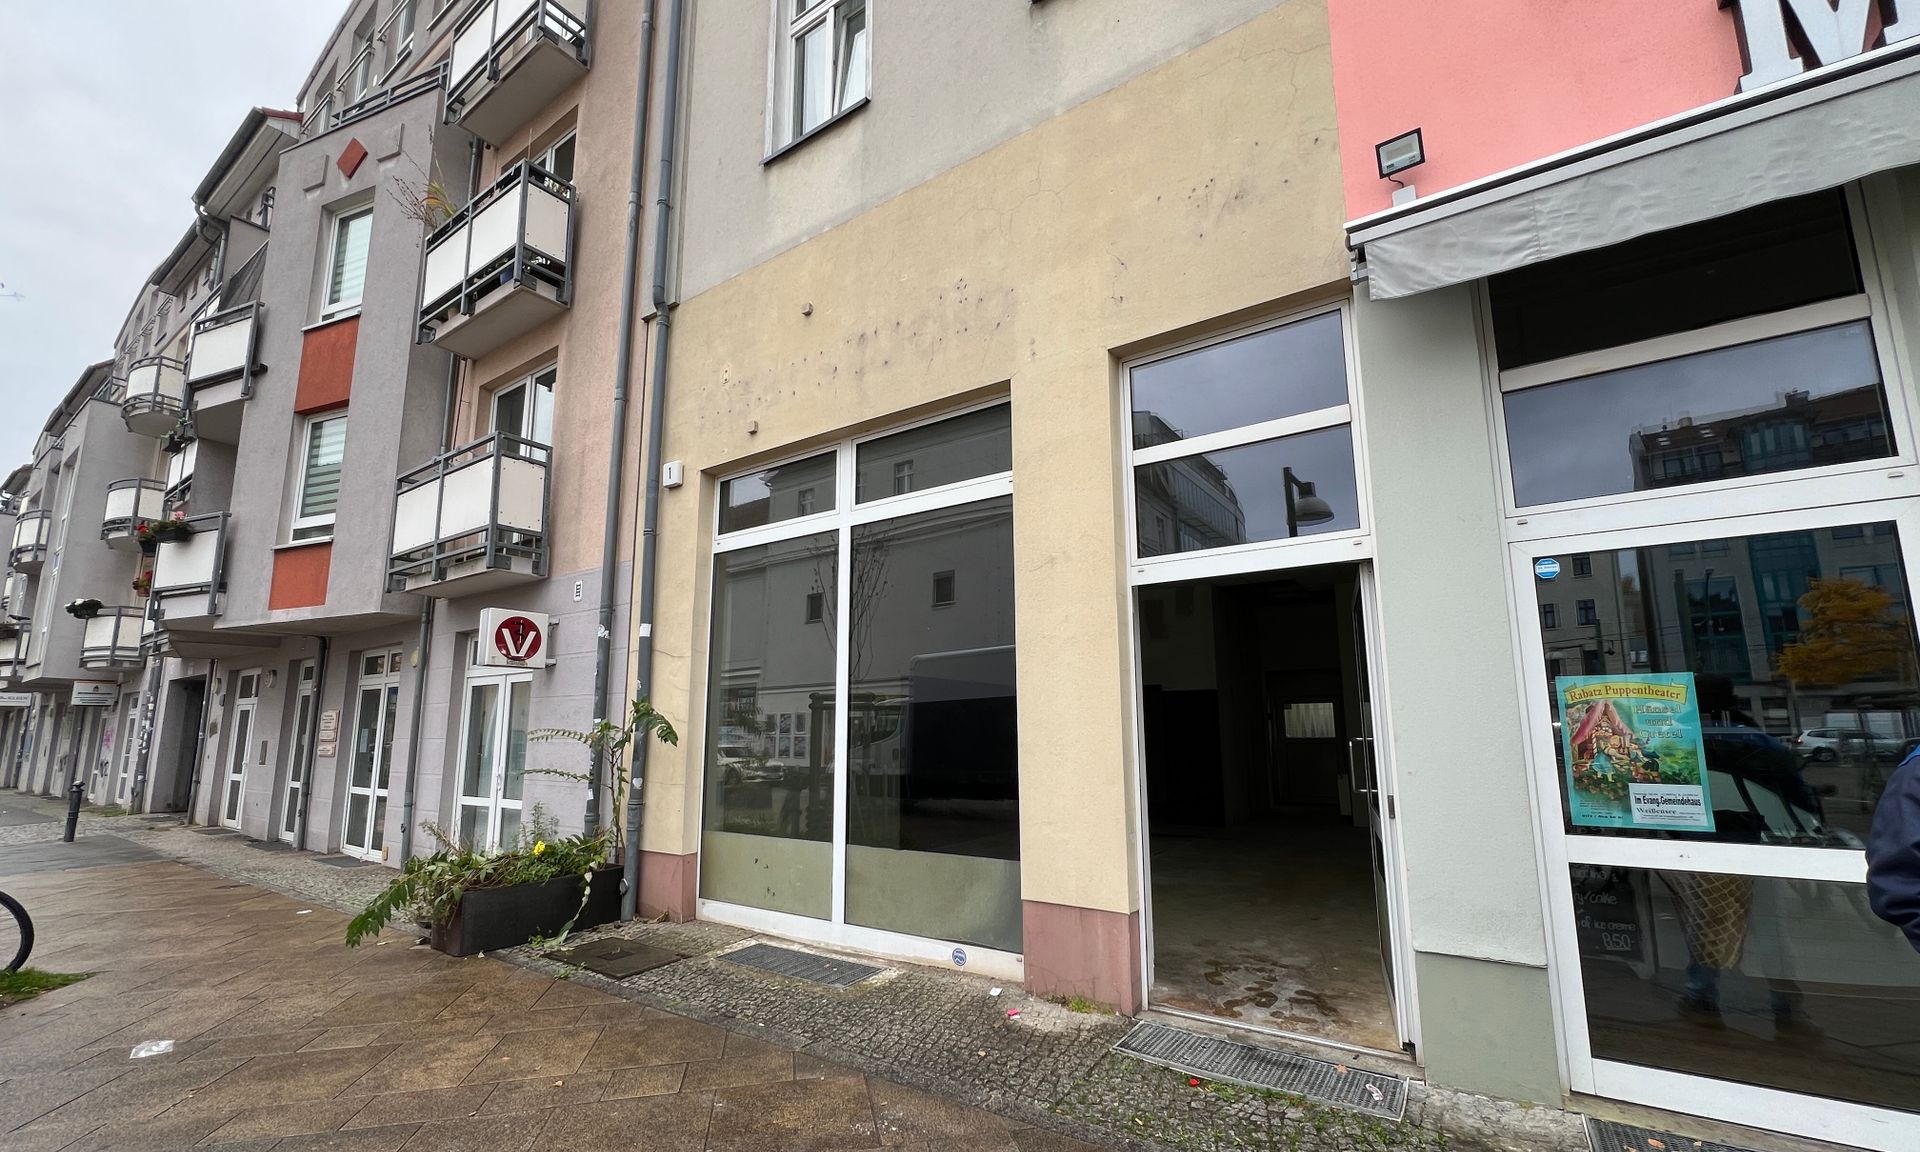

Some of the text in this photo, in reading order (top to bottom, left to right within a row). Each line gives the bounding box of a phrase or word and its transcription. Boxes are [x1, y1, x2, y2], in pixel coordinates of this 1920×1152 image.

[1569, 685, 1681, 702] Rabatz Puppentheater
[1634, 795, 1642, 804] Im
